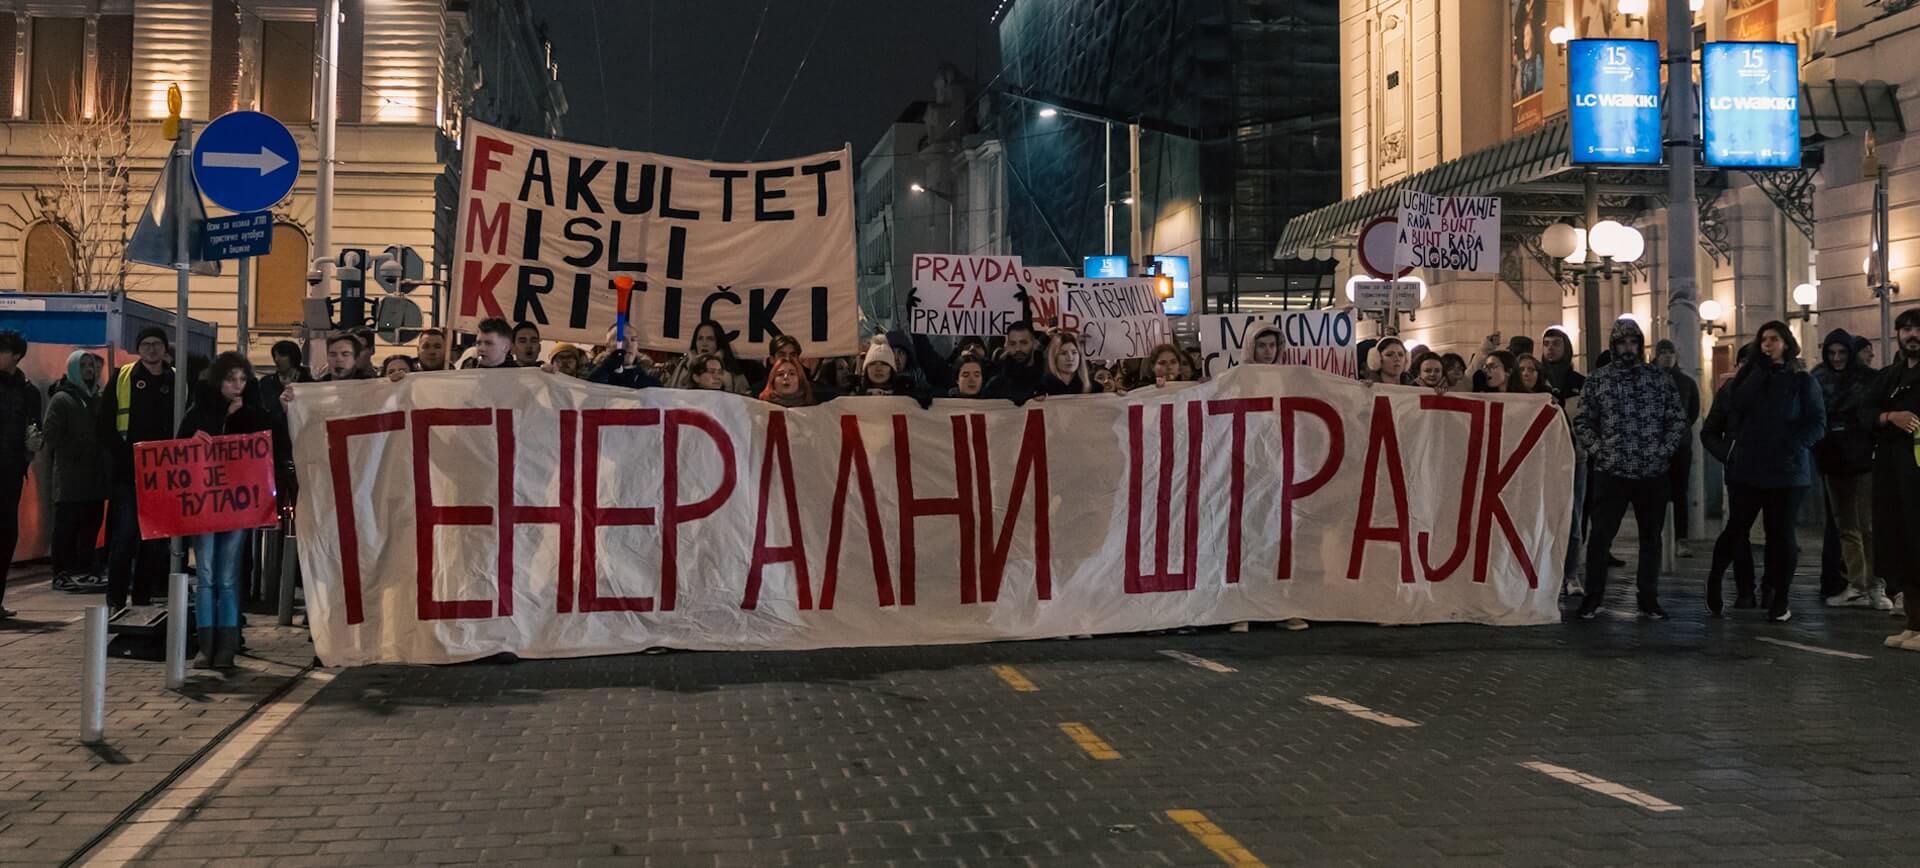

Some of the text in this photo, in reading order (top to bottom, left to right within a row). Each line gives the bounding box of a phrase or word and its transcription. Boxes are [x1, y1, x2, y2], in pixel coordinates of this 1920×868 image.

[1606, 46, 1627, 66] 15
[1742, 49, 1763, 68] 15
[1575, 94, 1597, 107] LC
[1710, 97, 1731, 110] LC
[471, 136, 841, 222] FAKULTET
[465, 198, 687, 281] MISLI
[1399, 228, 1407, 244] A
[1411, 230, 1441, 247] BUNT
[915, 256, 1019, 282] PRAVDA
[1411, 244, 1479, 272] SLOBODU
[460, 260, 828, 343] KRITIČKI
[948, 283, 987, 308] ZA
[914, 309, 1015, 335] PRAVNIKE
[144, 465, 227, 490] И КО ЈЕ
[176, 485, 260, 517] ЋУТАО!
[326, 395, 1558, 625] ГЕНЕРАЛНИ ШТРАЈК
